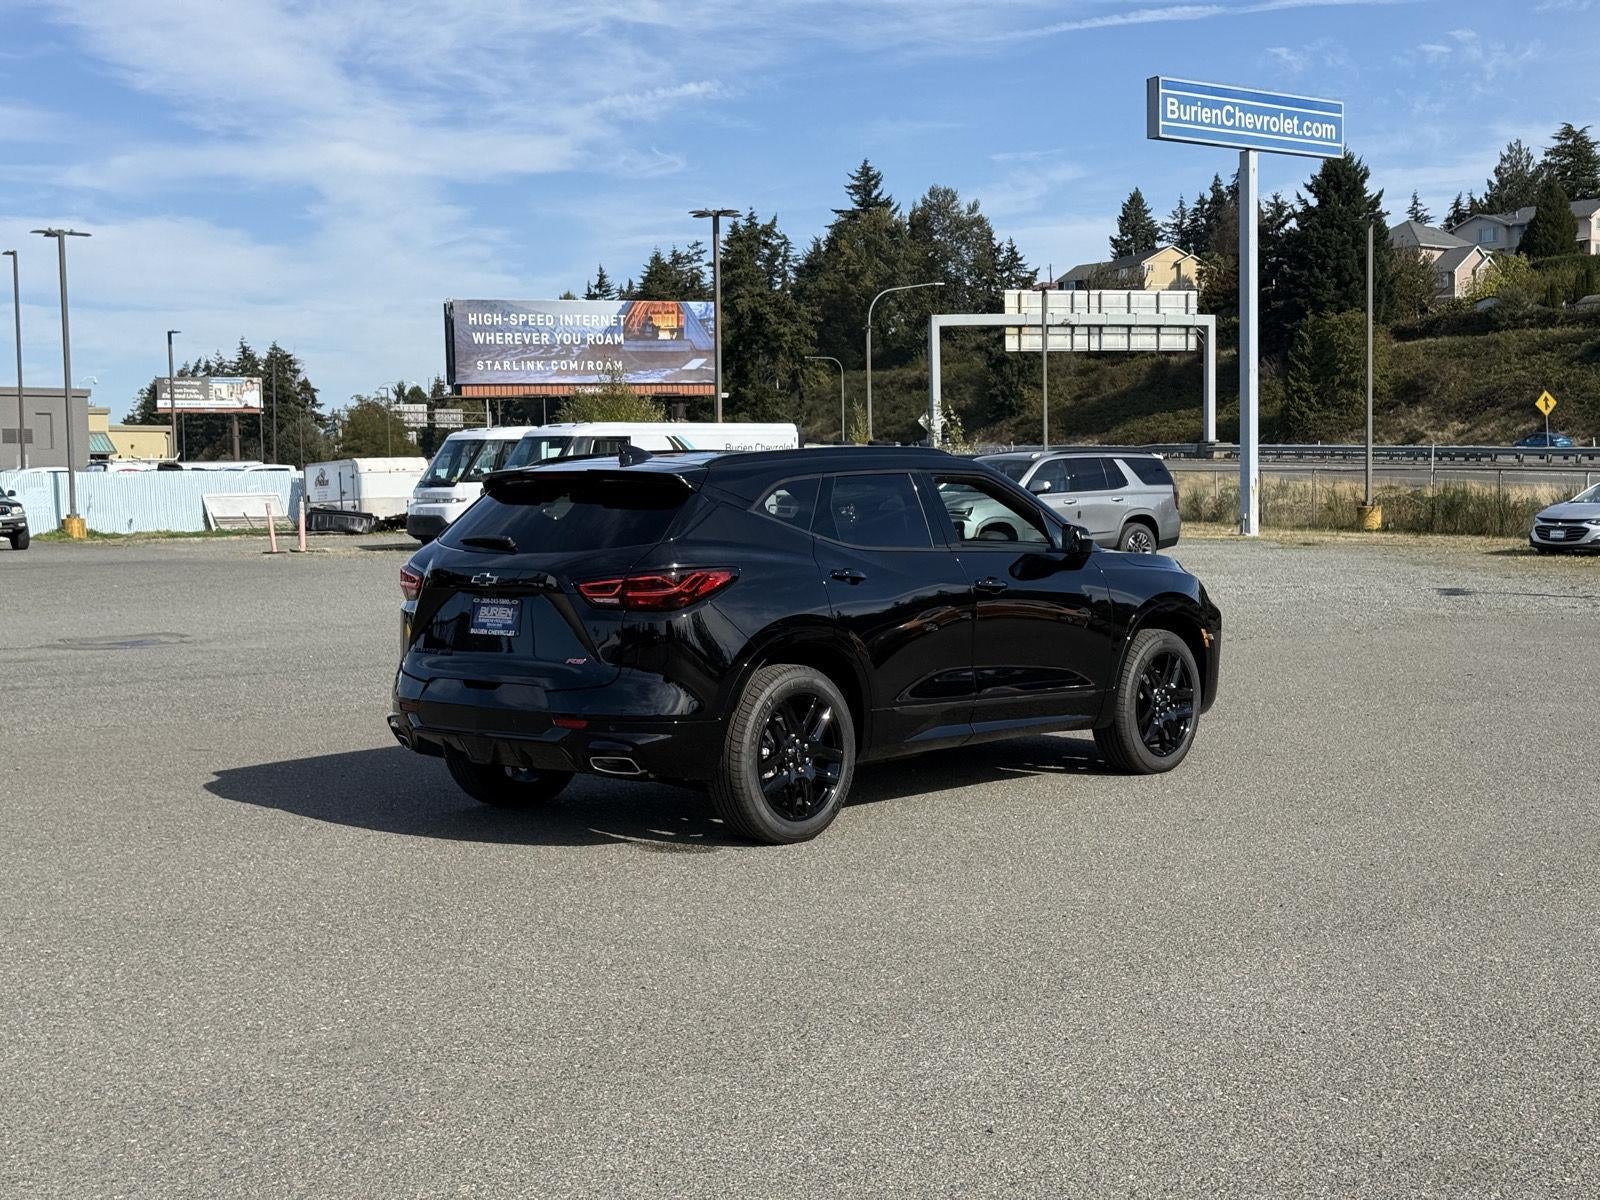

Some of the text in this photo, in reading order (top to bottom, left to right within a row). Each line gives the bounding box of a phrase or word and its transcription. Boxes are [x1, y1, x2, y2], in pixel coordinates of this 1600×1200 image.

[1166, 97, 1336, 139] BurienChevrolet.com
[468, 313, 626, 327] HIGH-SPEED INTERNET
[472, 332, 625, 345] WHEREVER YOU ROAM
[476, 360, 623, 371] STARLINK.COM/ROAM
[755, 443, 794, 451] Chevrolet
[479, 606, 513, 618] BURIEN
